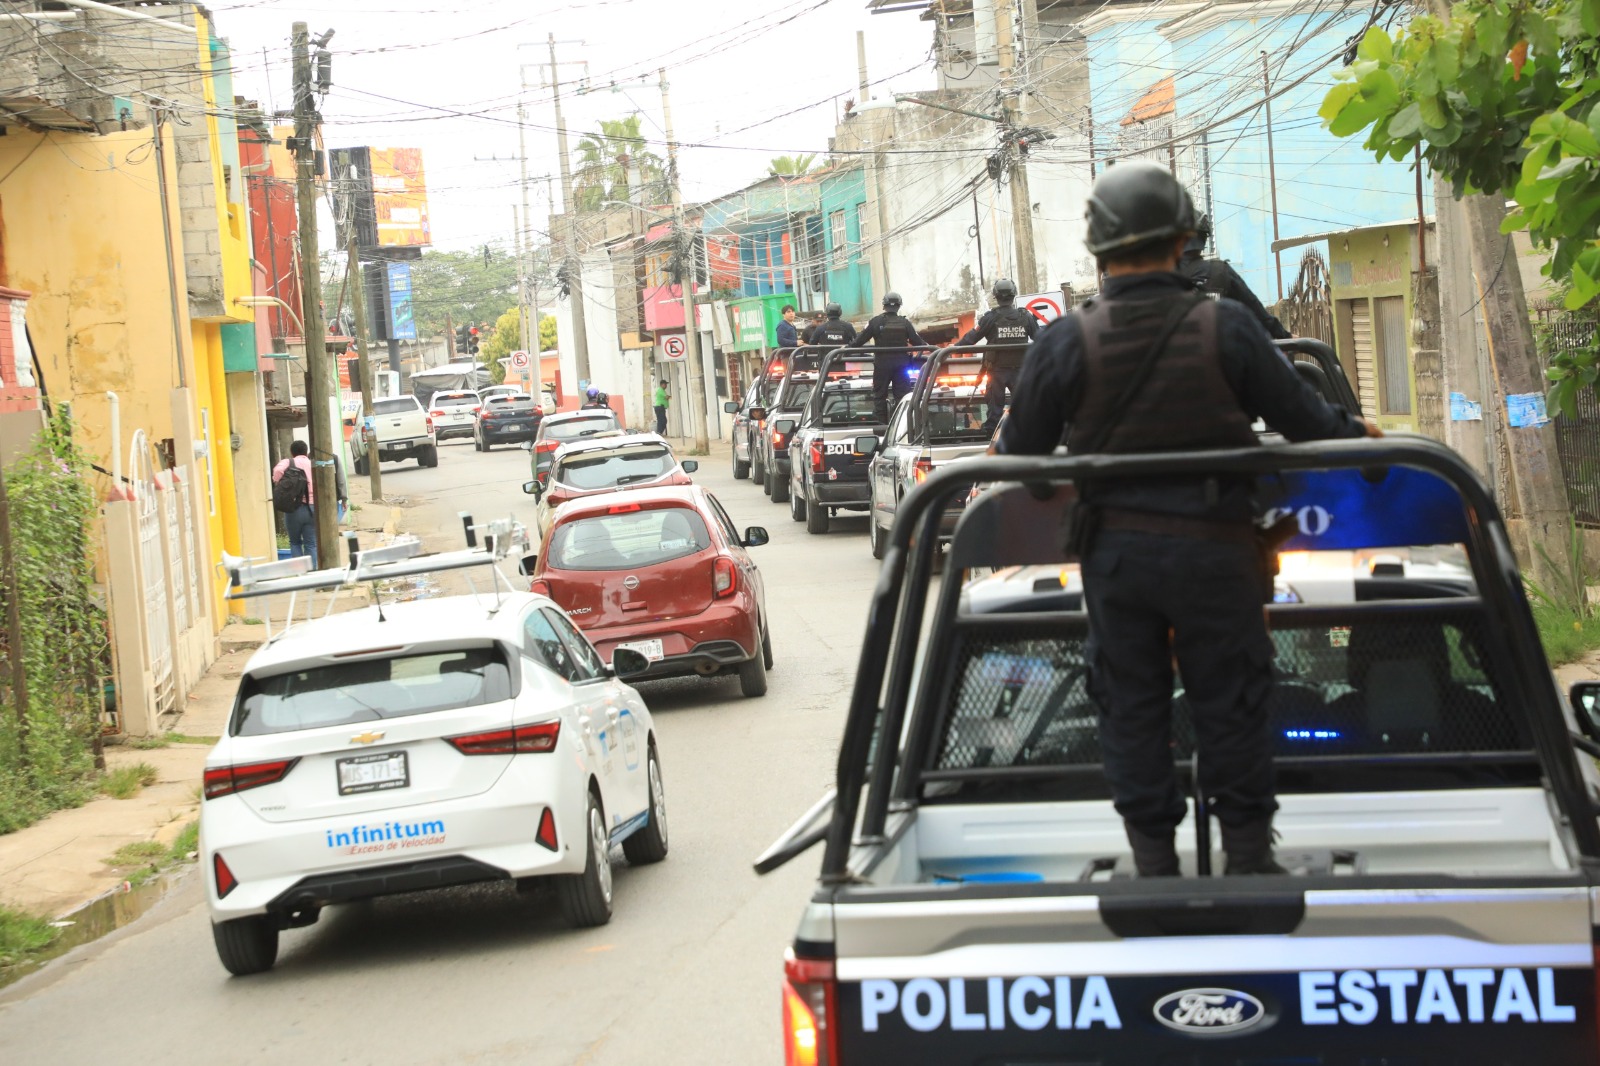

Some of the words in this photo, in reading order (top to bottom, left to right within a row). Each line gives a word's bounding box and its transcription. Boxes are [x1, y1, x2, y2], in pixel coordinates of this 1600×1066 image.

[827, 444, 855, 455] POLI
[565, 606, 592, 616] MARCH
[325, 819, 445, 848] infinitum
[350, 844, 385, 855] Exceso
[386, 841, 399, 850] de
[401, 834, 447, 849] Velocidad
[860, 975, 1122, 1032] POLICIA
[1171, 993, 1244, 1027] Ford
[1299, 967, 1577, 1026] ESTATAL
